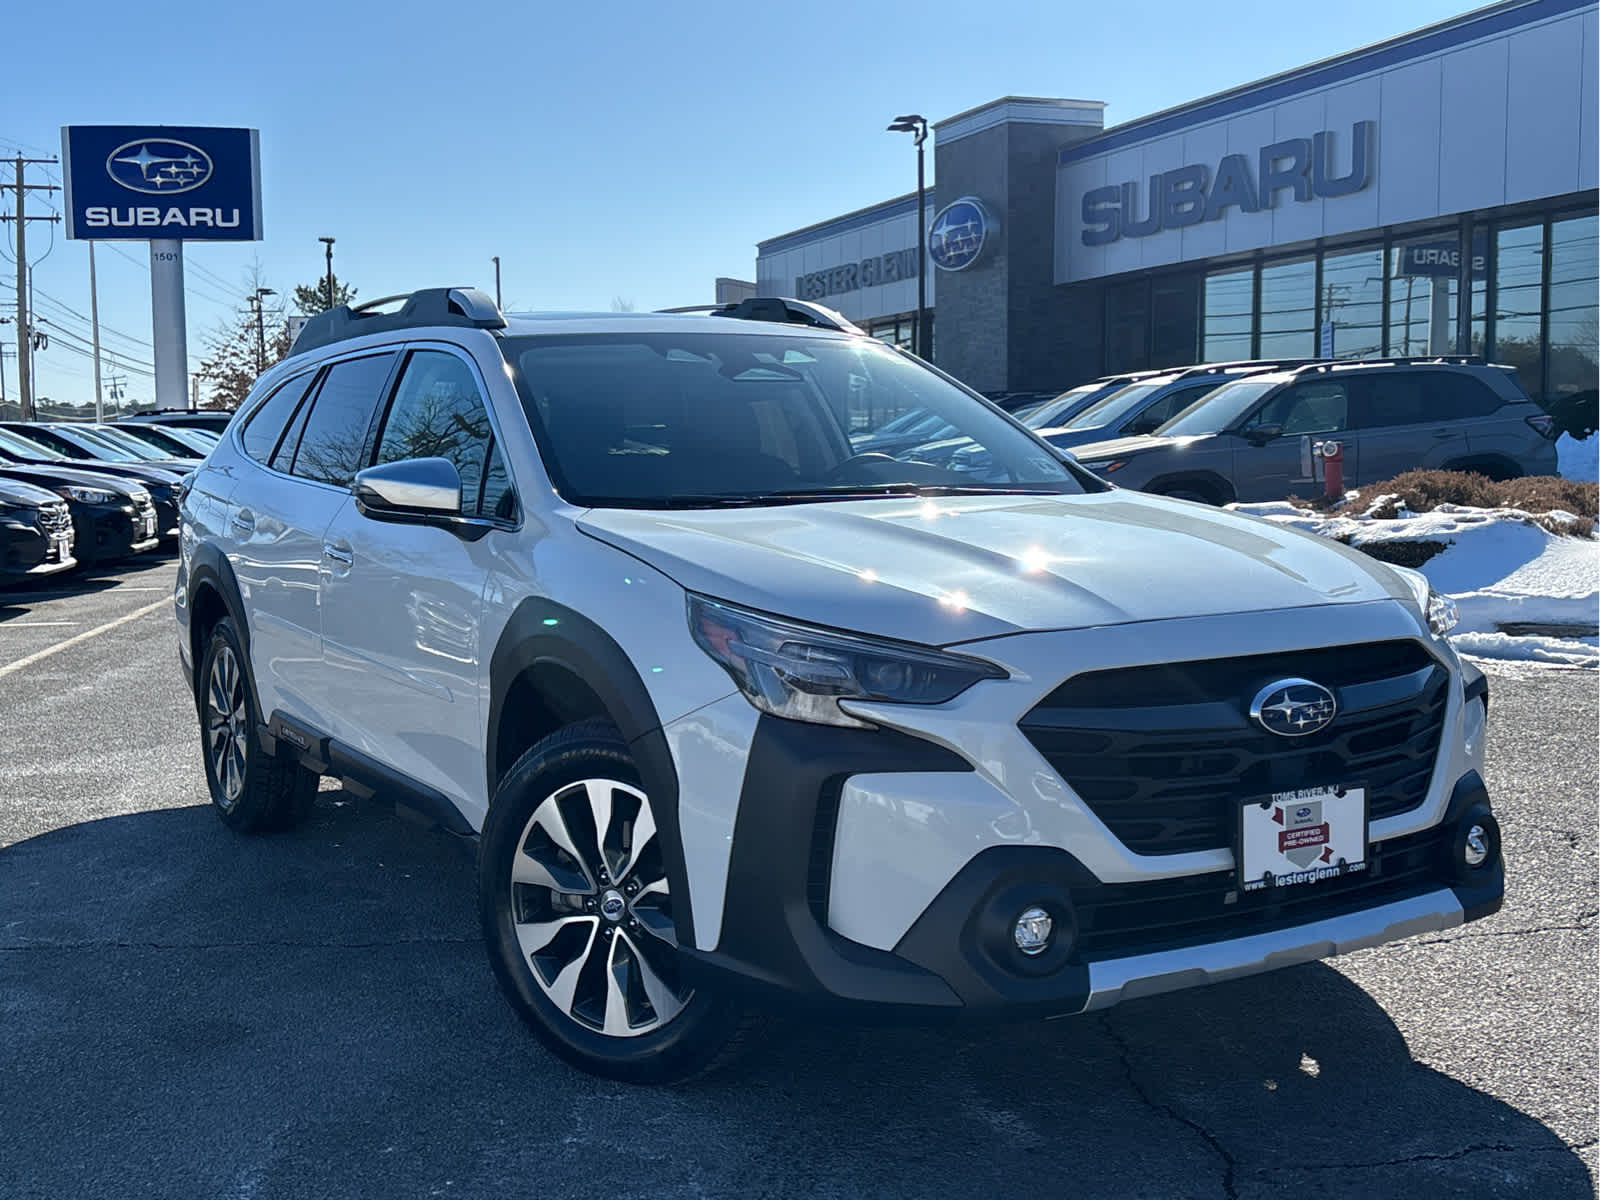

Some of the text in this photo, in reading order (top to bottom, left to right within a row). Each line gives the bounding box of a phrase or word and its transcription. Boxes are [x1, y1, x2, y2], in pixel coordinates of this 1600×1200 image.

[1081, 120, 1376, 247] SUBARU
[85, 207, 240, 228] SUBARU
[154, 252, 178, 262] 1501
[796, 263, 859, 300] LESTER
[1272, 790, 1296, 802] TOMS
[1328, 784, 1339, 796] NJ
[1284, 835, 1324, 847] PRE-OWNED
[1287, 828, 1321, 840] CERTIFIED
[1275, 866, 1340, 888] lesterglenn
